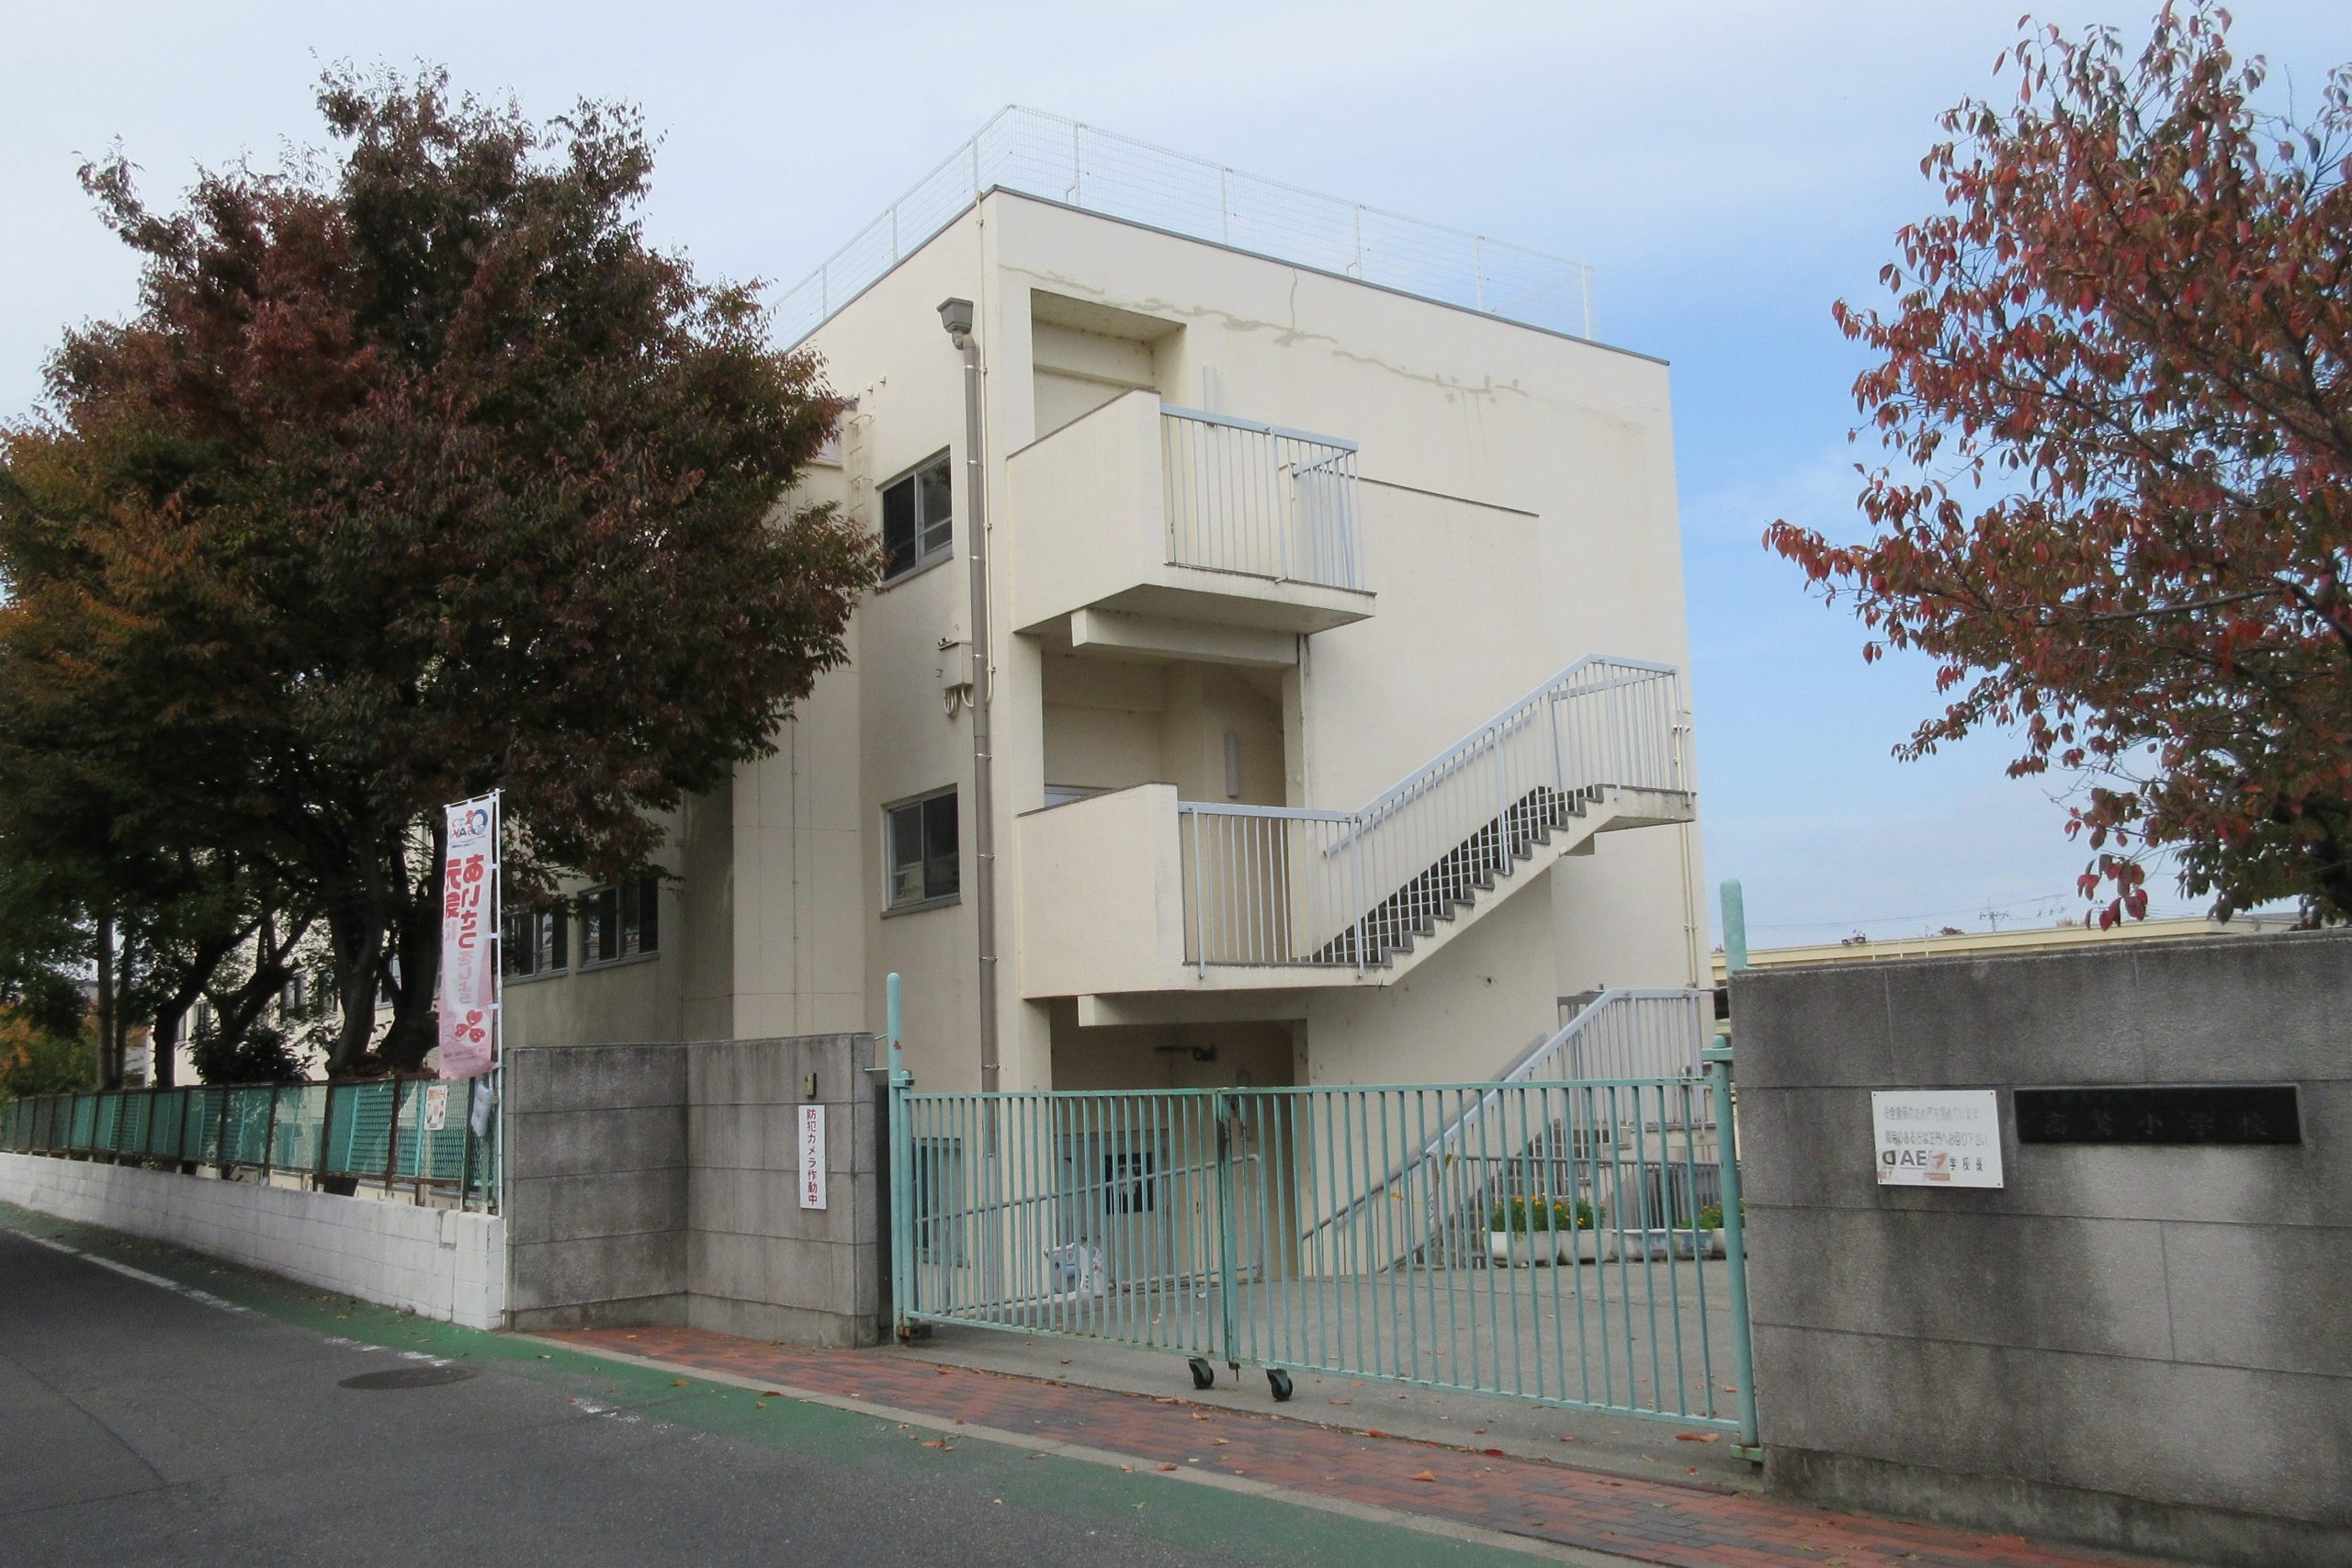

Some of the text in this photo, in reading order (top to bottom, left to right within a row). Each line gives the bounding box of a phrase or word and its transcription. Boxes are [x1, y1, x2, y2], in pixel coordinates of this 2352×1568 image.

[806, 1108, 818, 1205] 防犯カメラ作動中
